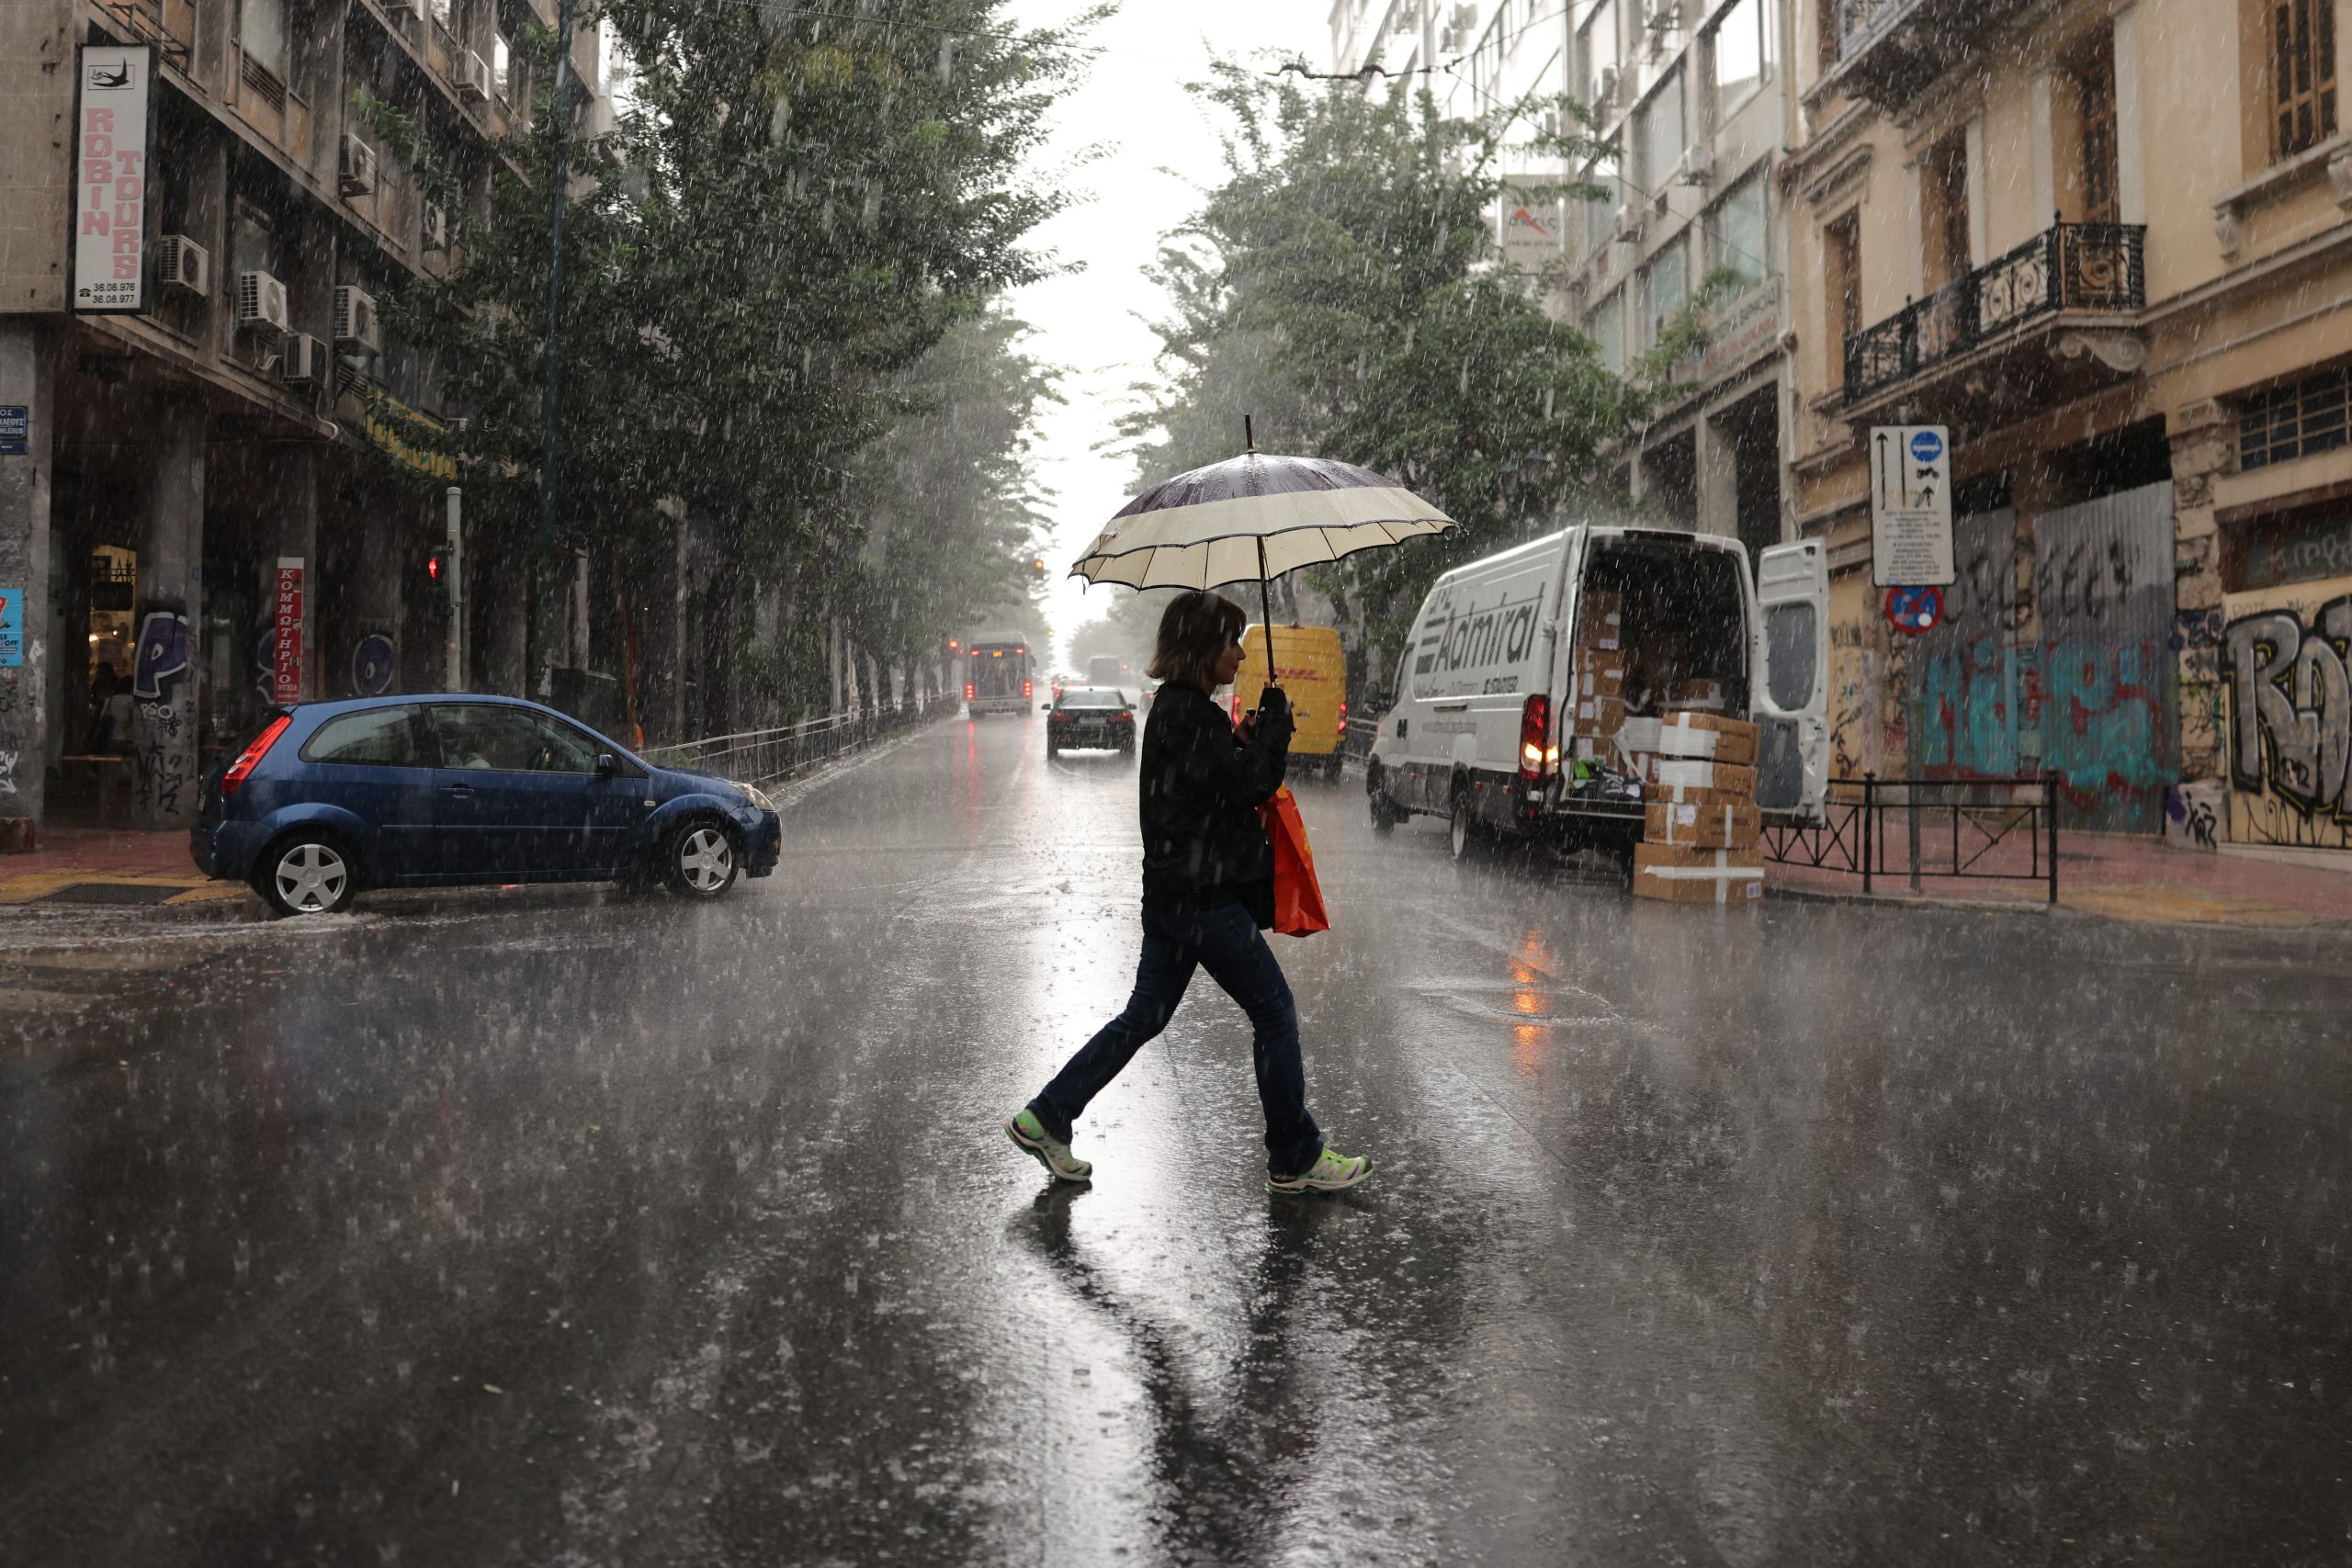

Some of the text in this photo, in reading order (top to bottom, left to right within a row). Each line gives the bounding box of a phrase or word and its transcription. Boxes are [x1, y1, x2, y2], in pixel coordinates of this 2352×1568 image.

[83, 107, 114, 236] ROBIN
[112, 150, 142, 279] TOURS
[92, 294, 135, 304] 36.08.977
[93, 282, 136, 292] 36.08.976
[278, 570, 294, 684] ΚΟΜΜΩΤΗΡΙΟ
[1433, 581, 1545, 673] Admiral
